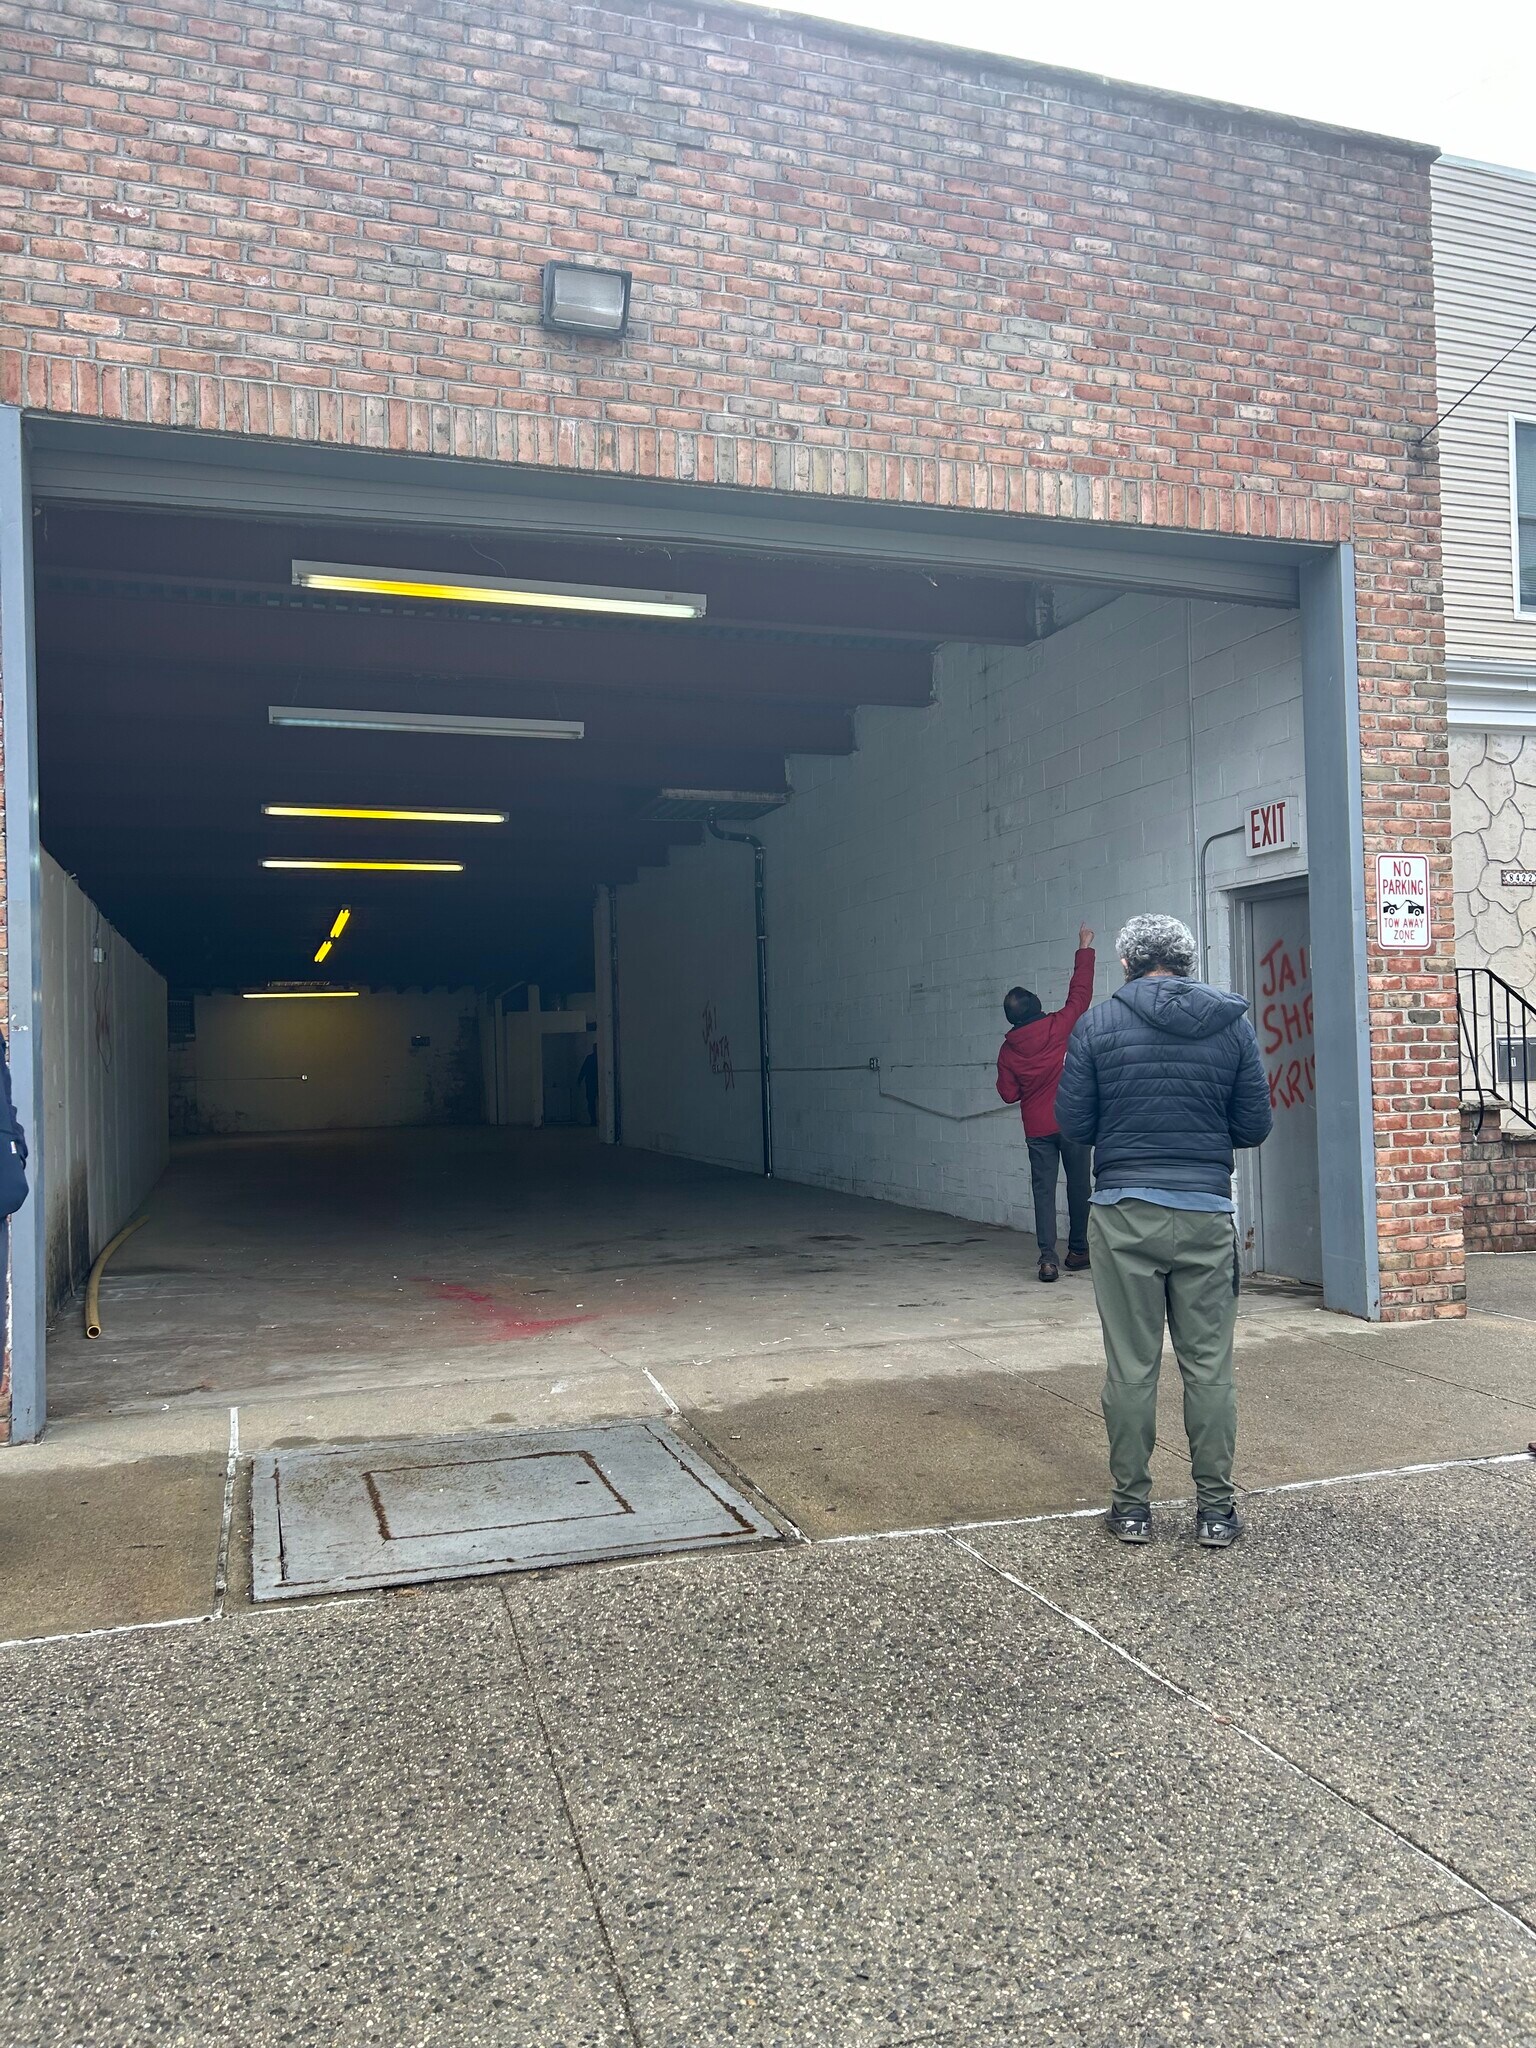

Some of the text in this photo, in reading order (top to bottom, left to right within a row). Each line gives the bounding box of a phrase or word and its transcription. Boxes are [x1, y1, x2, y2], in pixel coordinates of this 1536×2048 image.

[1250, 801, 1286, 849] EXIT
[1393, 861, 1412, 877] NO
[1508, 874, 1533, 882] 8422
[1382, 879, 1424, 896] PARKING
[1384, 917, 1424, 928] TOW AWAY
[1393, 929, 1415, 940] ZONE
[1260, 938, 1307, 997] JAI
